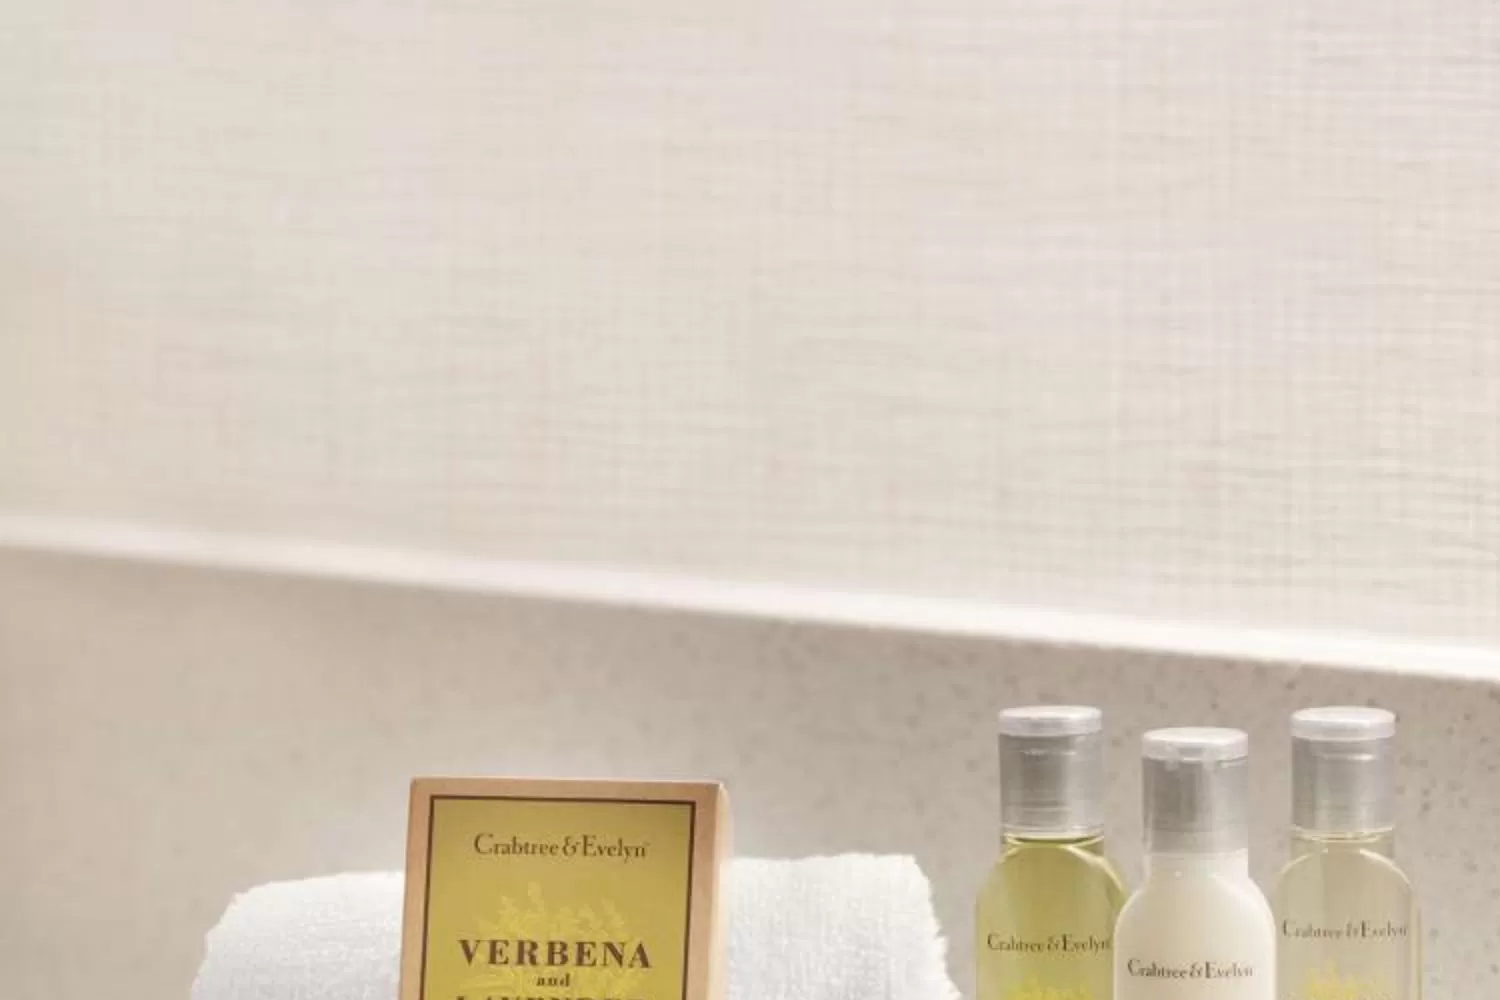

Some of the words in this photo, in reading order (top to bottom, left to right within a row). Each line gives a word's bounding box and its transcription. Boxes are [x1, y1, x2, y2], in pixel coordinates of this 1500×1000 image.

[474, 832, 559, 857] Crabtree
[582, 834, 647, 864] Evelyn
[457, 938, 652, 969] VERBENA
[536, 972, 571, 988] and
